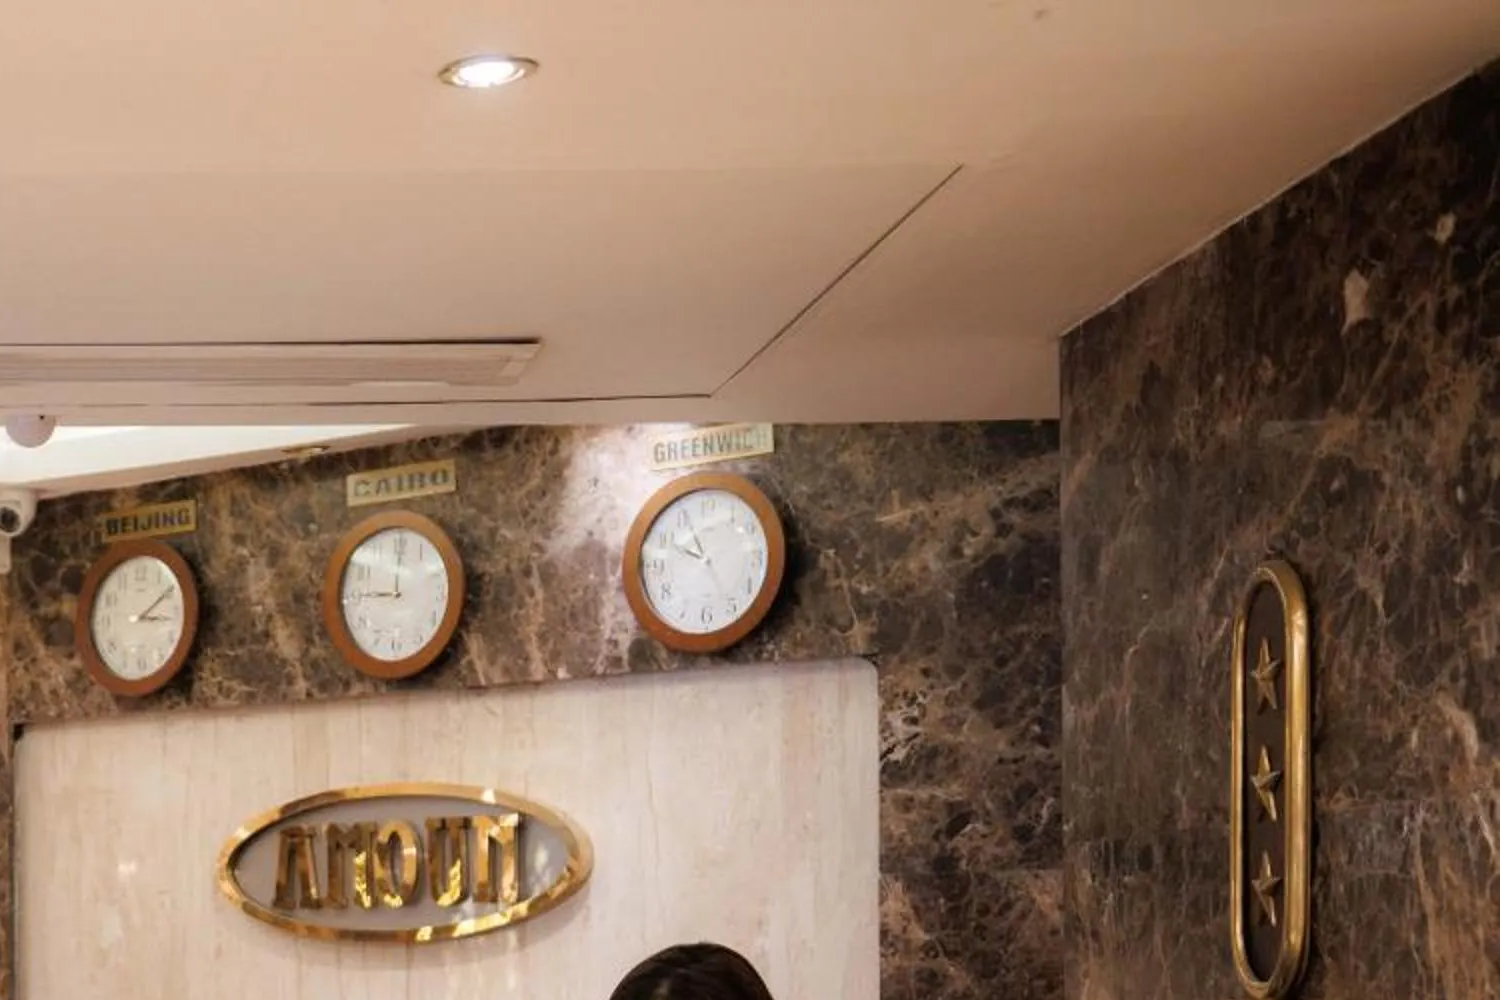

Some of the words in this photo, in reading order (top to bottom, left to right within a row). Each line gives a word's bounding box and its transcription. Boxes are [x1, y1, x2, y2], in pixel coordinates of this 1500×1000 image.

[653, 428, 770, 464] GREENWICH
[354, 468, 449, 498] CAIRO
[105, 507, 190, 536] BEIJING
[272, 812, 521, 910] AMOUN
